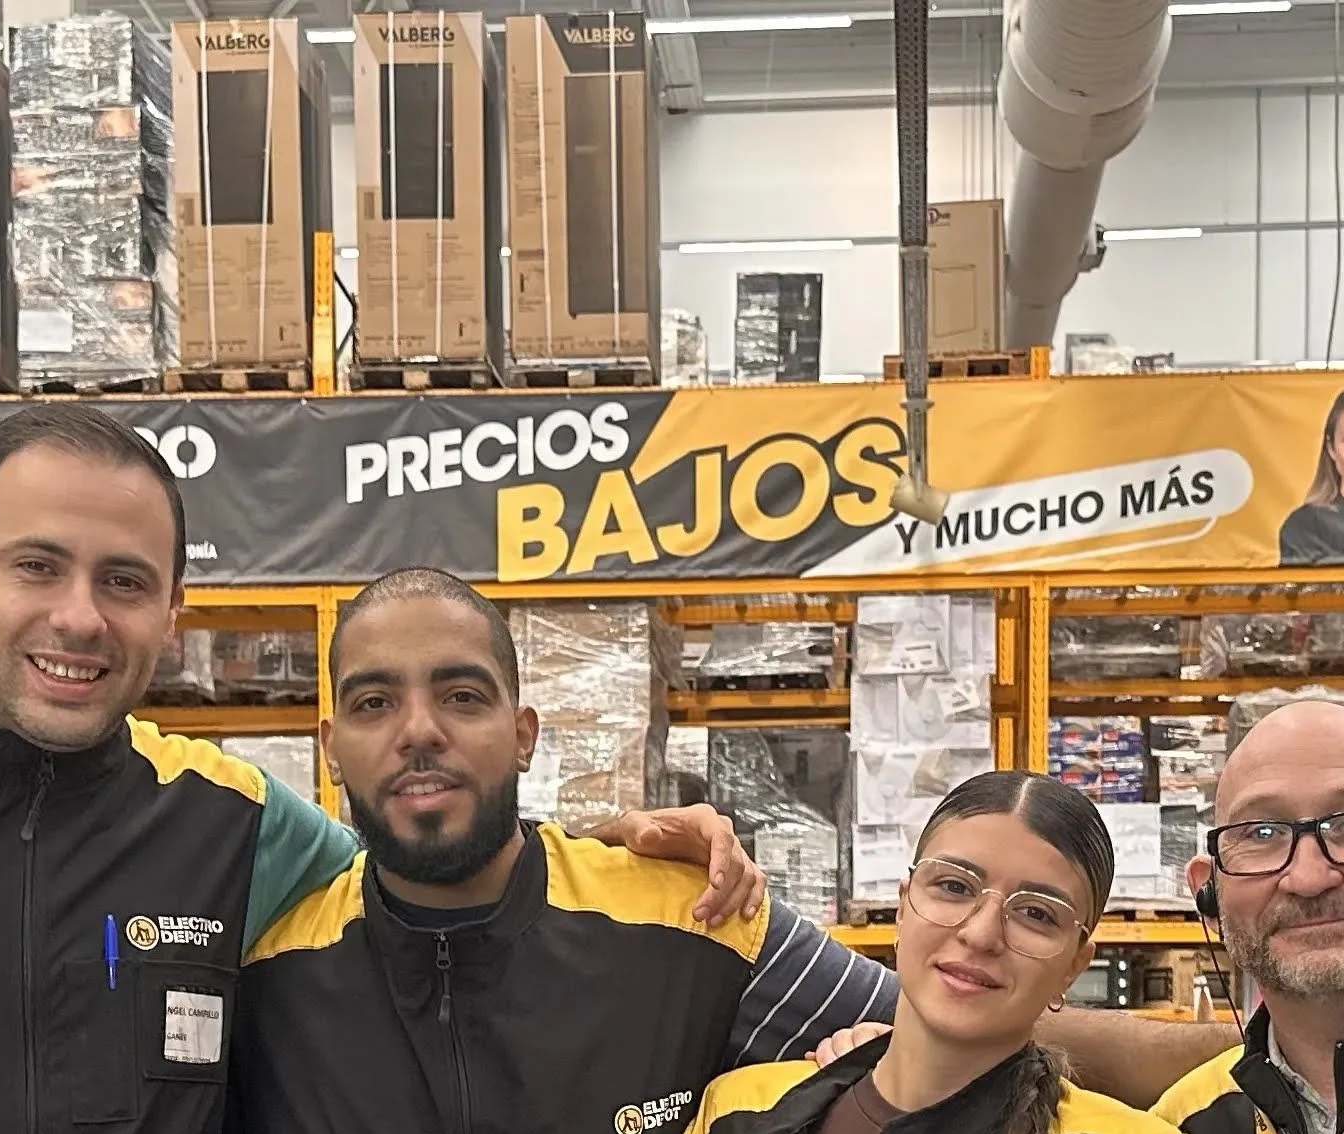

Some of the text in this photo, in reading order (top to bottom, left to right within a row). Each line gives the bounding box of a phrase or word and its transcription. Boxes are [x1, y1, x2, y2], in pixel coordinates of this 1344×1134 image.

[378, 27, 455, 43] VALBERG
[564, 26, 636, 43] VALBERG
[345, 401, 631, 504] PRECIOS
[496, 421, 907, 583] BAJOS
[895, 465, 1215, 555] Y MUCHO MÁS
[157, 915, 224, 934] ELECTRO
[160, 930, 210, 947] DEPOT
[167, 1006, 187, 1017] NGEL
